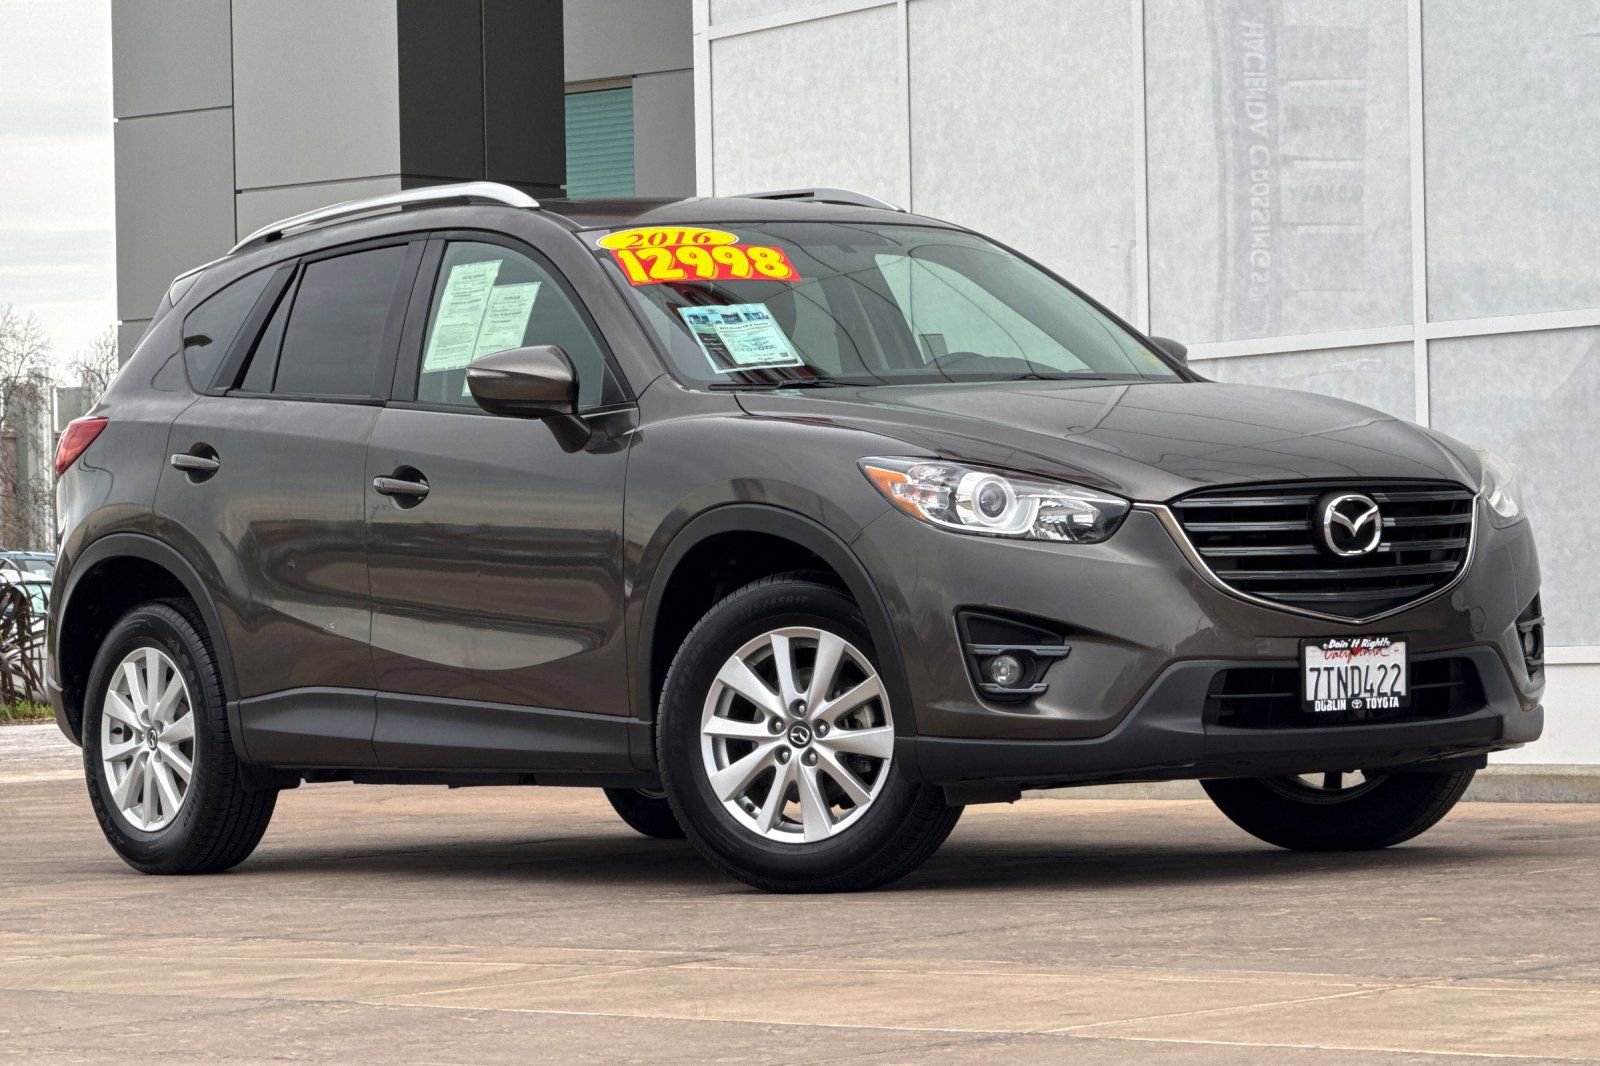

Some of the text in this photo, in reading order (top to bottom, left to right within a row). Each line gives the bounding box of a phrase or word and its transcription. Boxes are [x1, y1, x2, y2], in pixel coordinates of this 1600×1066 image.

[625, 231, 711, 248] 2016
[617, 245, 794, 282] 12998
[1328, 638, 1351, 649] Doin'
[1351, 638, 1361, 648] It
[1324, 648, 1389, 664] Califrnia
[1309, 663, 1401, 699] 7TND422
[1314, 696, 1400, 712] DUBLIN TOYOTA
